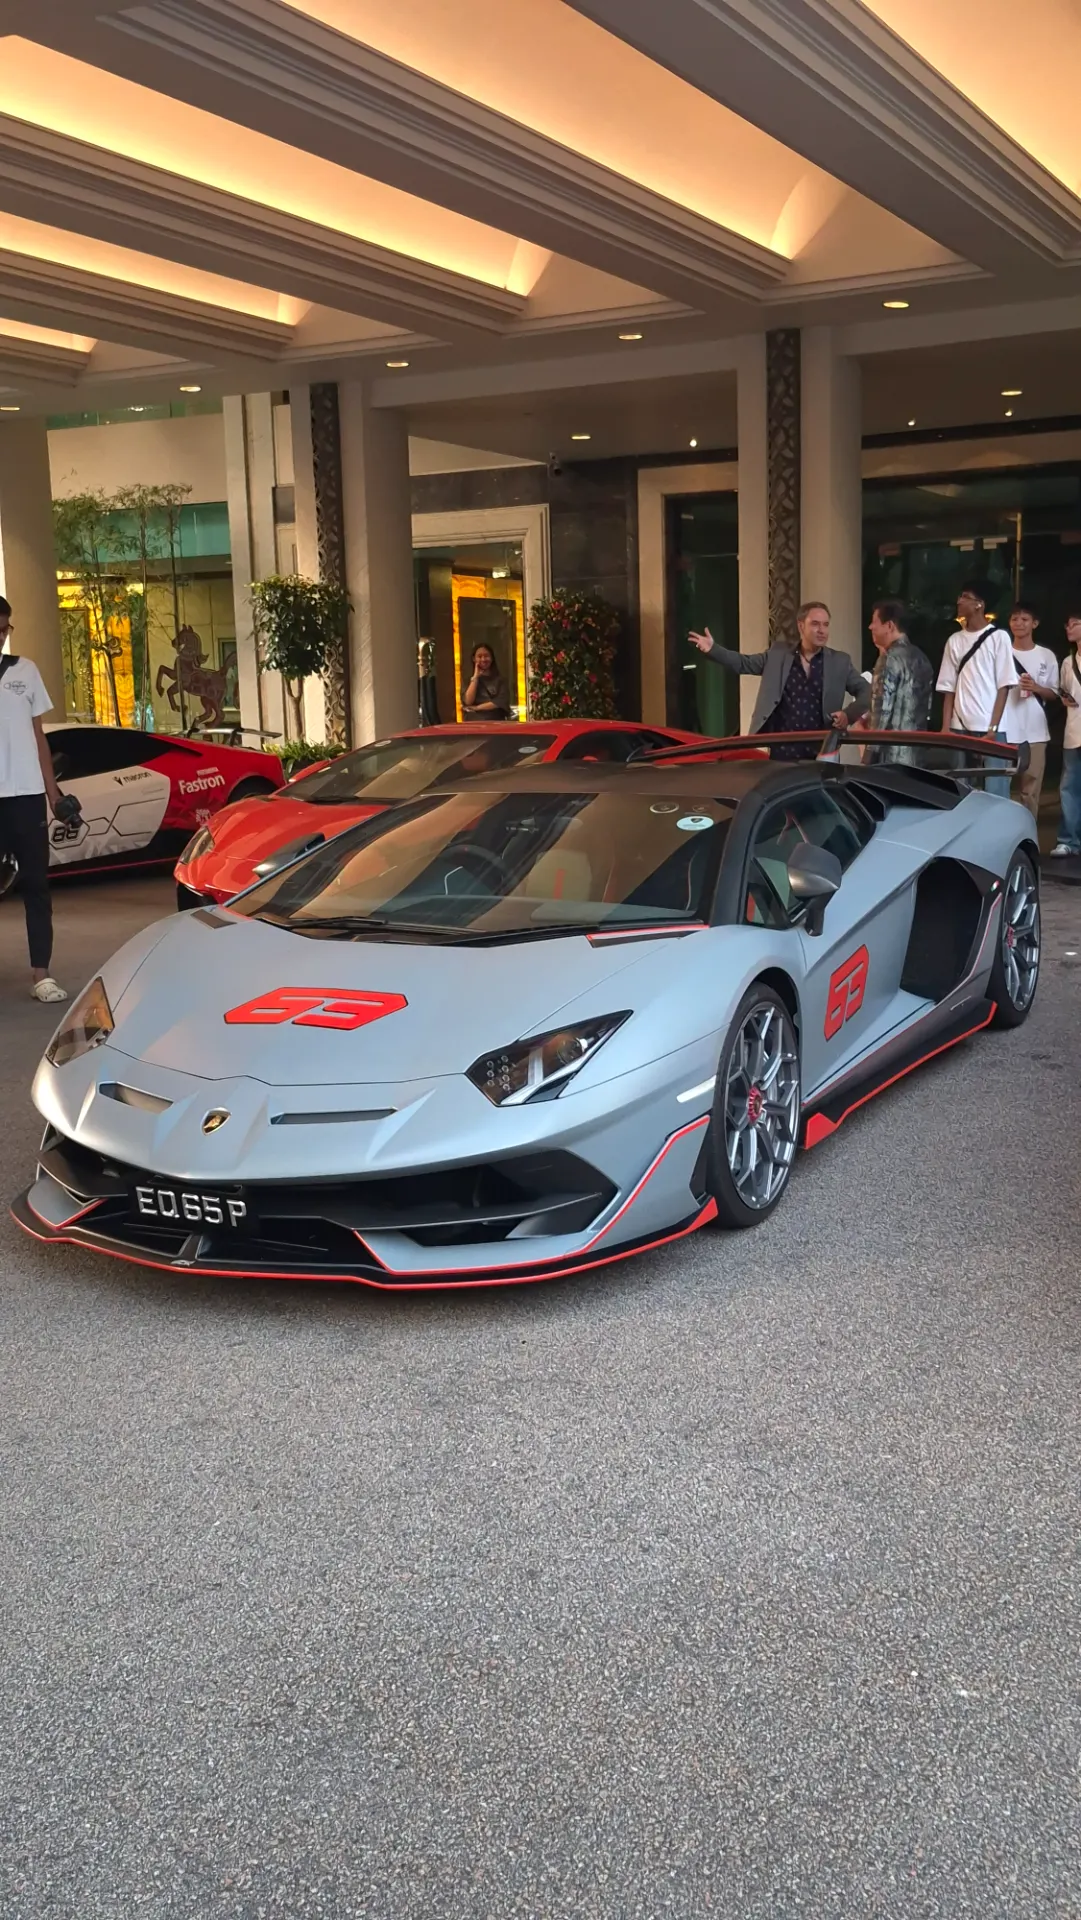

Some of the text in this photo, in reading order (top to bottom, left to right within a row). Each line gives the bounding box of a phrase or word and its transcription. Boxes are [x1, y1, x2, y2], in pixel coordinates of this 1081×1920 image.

[178, 774, 225, 795] Fastron
[224, 986, 409, 1031] 63
[823, 943, 870, 1042] 63
[135, 1186, 247, 1228] EQ65P
